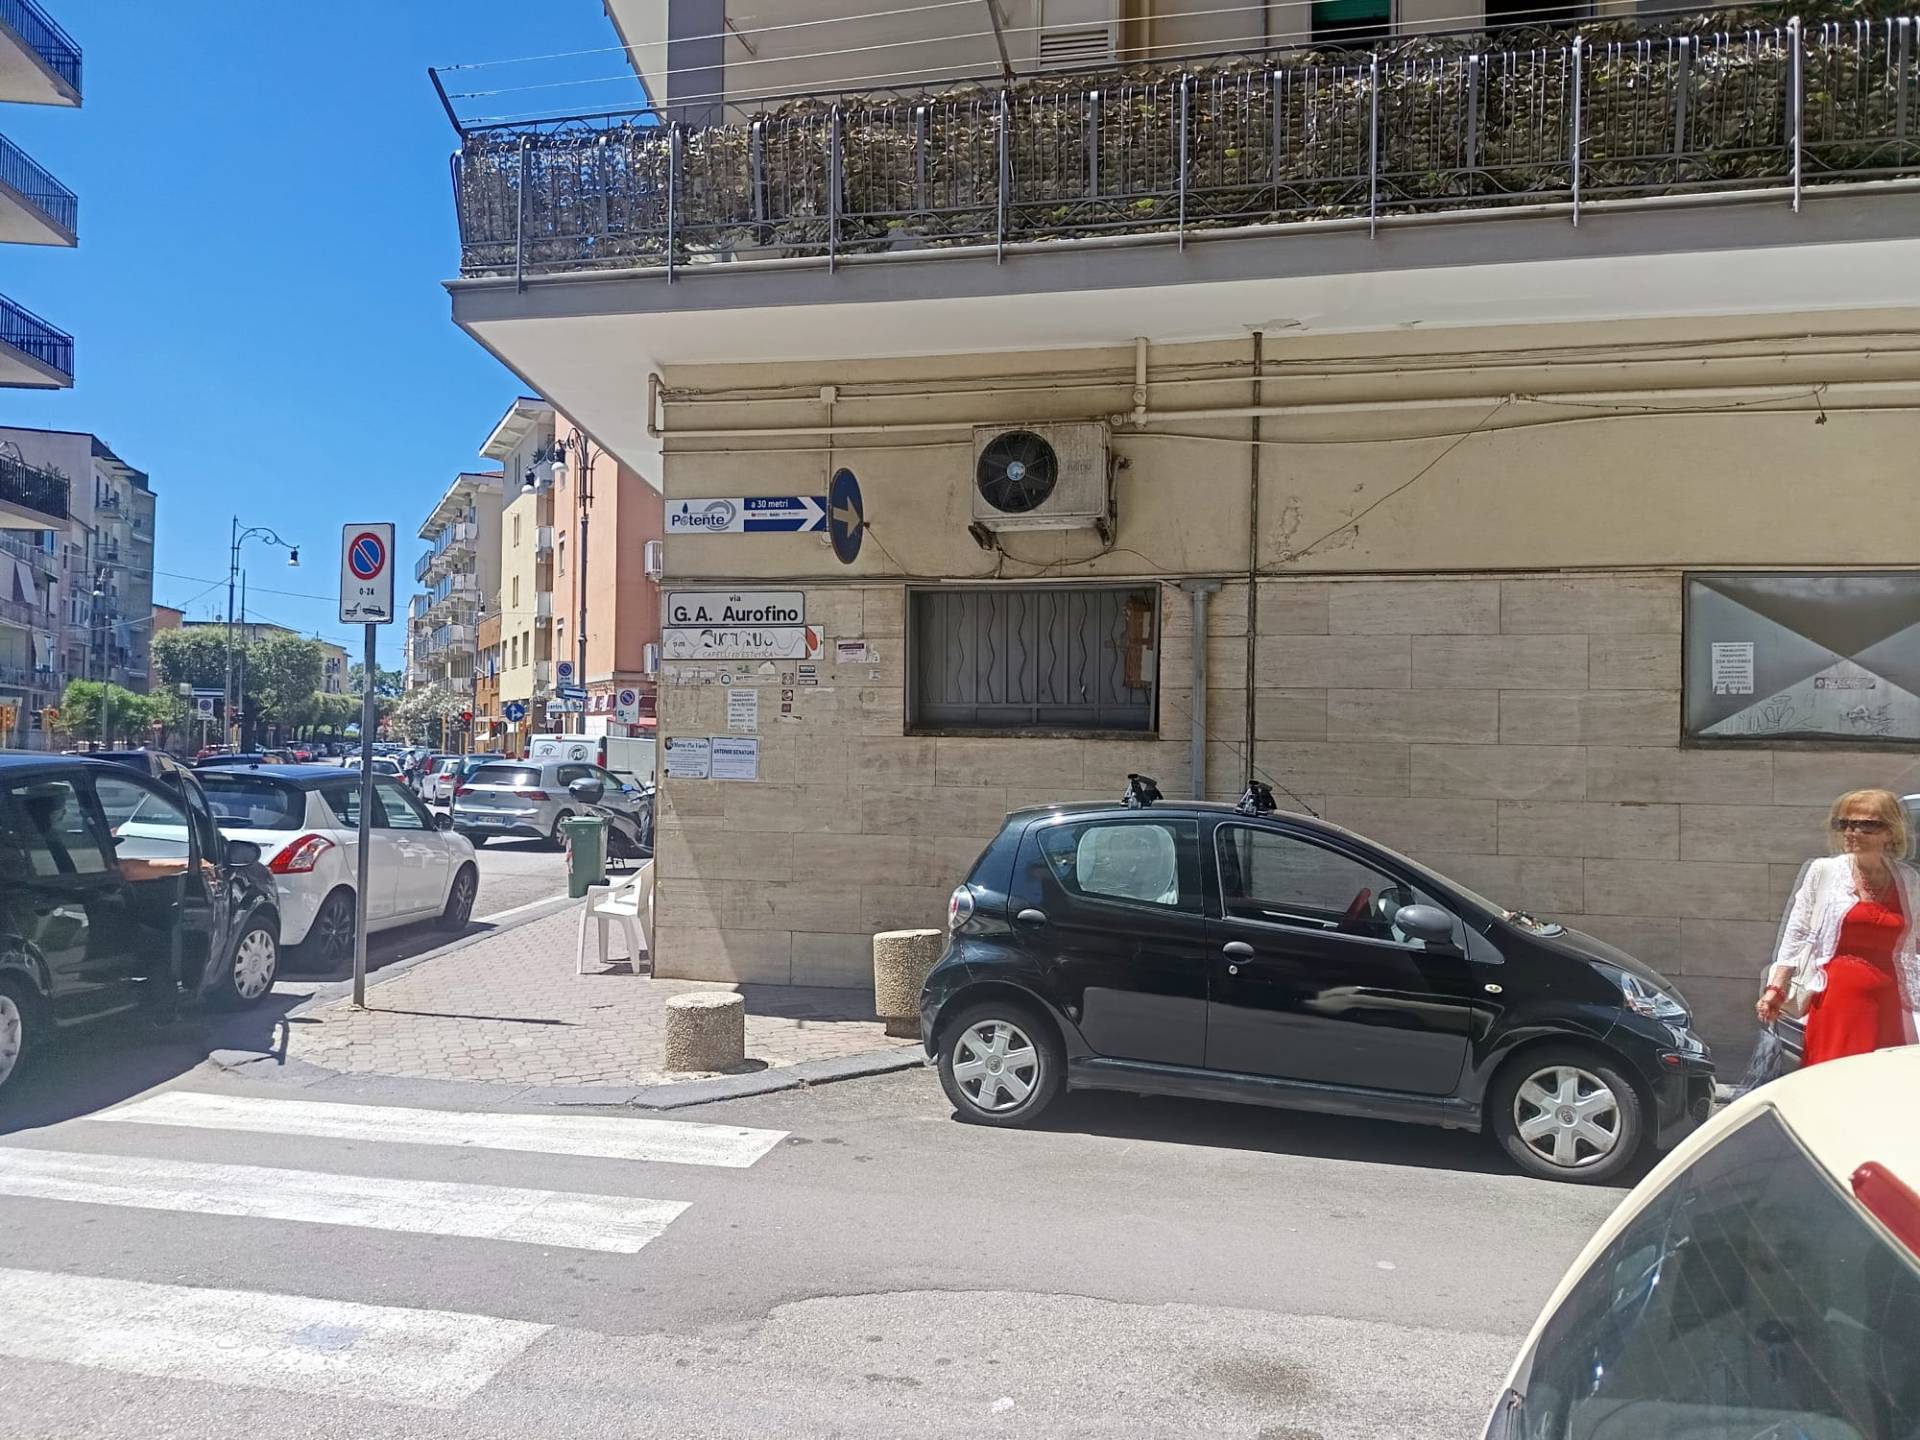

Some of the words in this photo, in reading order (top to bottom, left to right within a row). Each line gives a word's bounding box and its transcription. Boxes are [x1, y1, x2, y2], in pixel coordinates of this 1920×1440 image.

[757, 500, 767, 508] 30
[768, 499, 789, 508] metri
[672, 514, 725, 526] Potente
[729, 594, 741, 602] via
[674, 606, 691, 622] G.
[695, 606, 712, 622] A.
[722, 605, 798, 622] Aurofino
